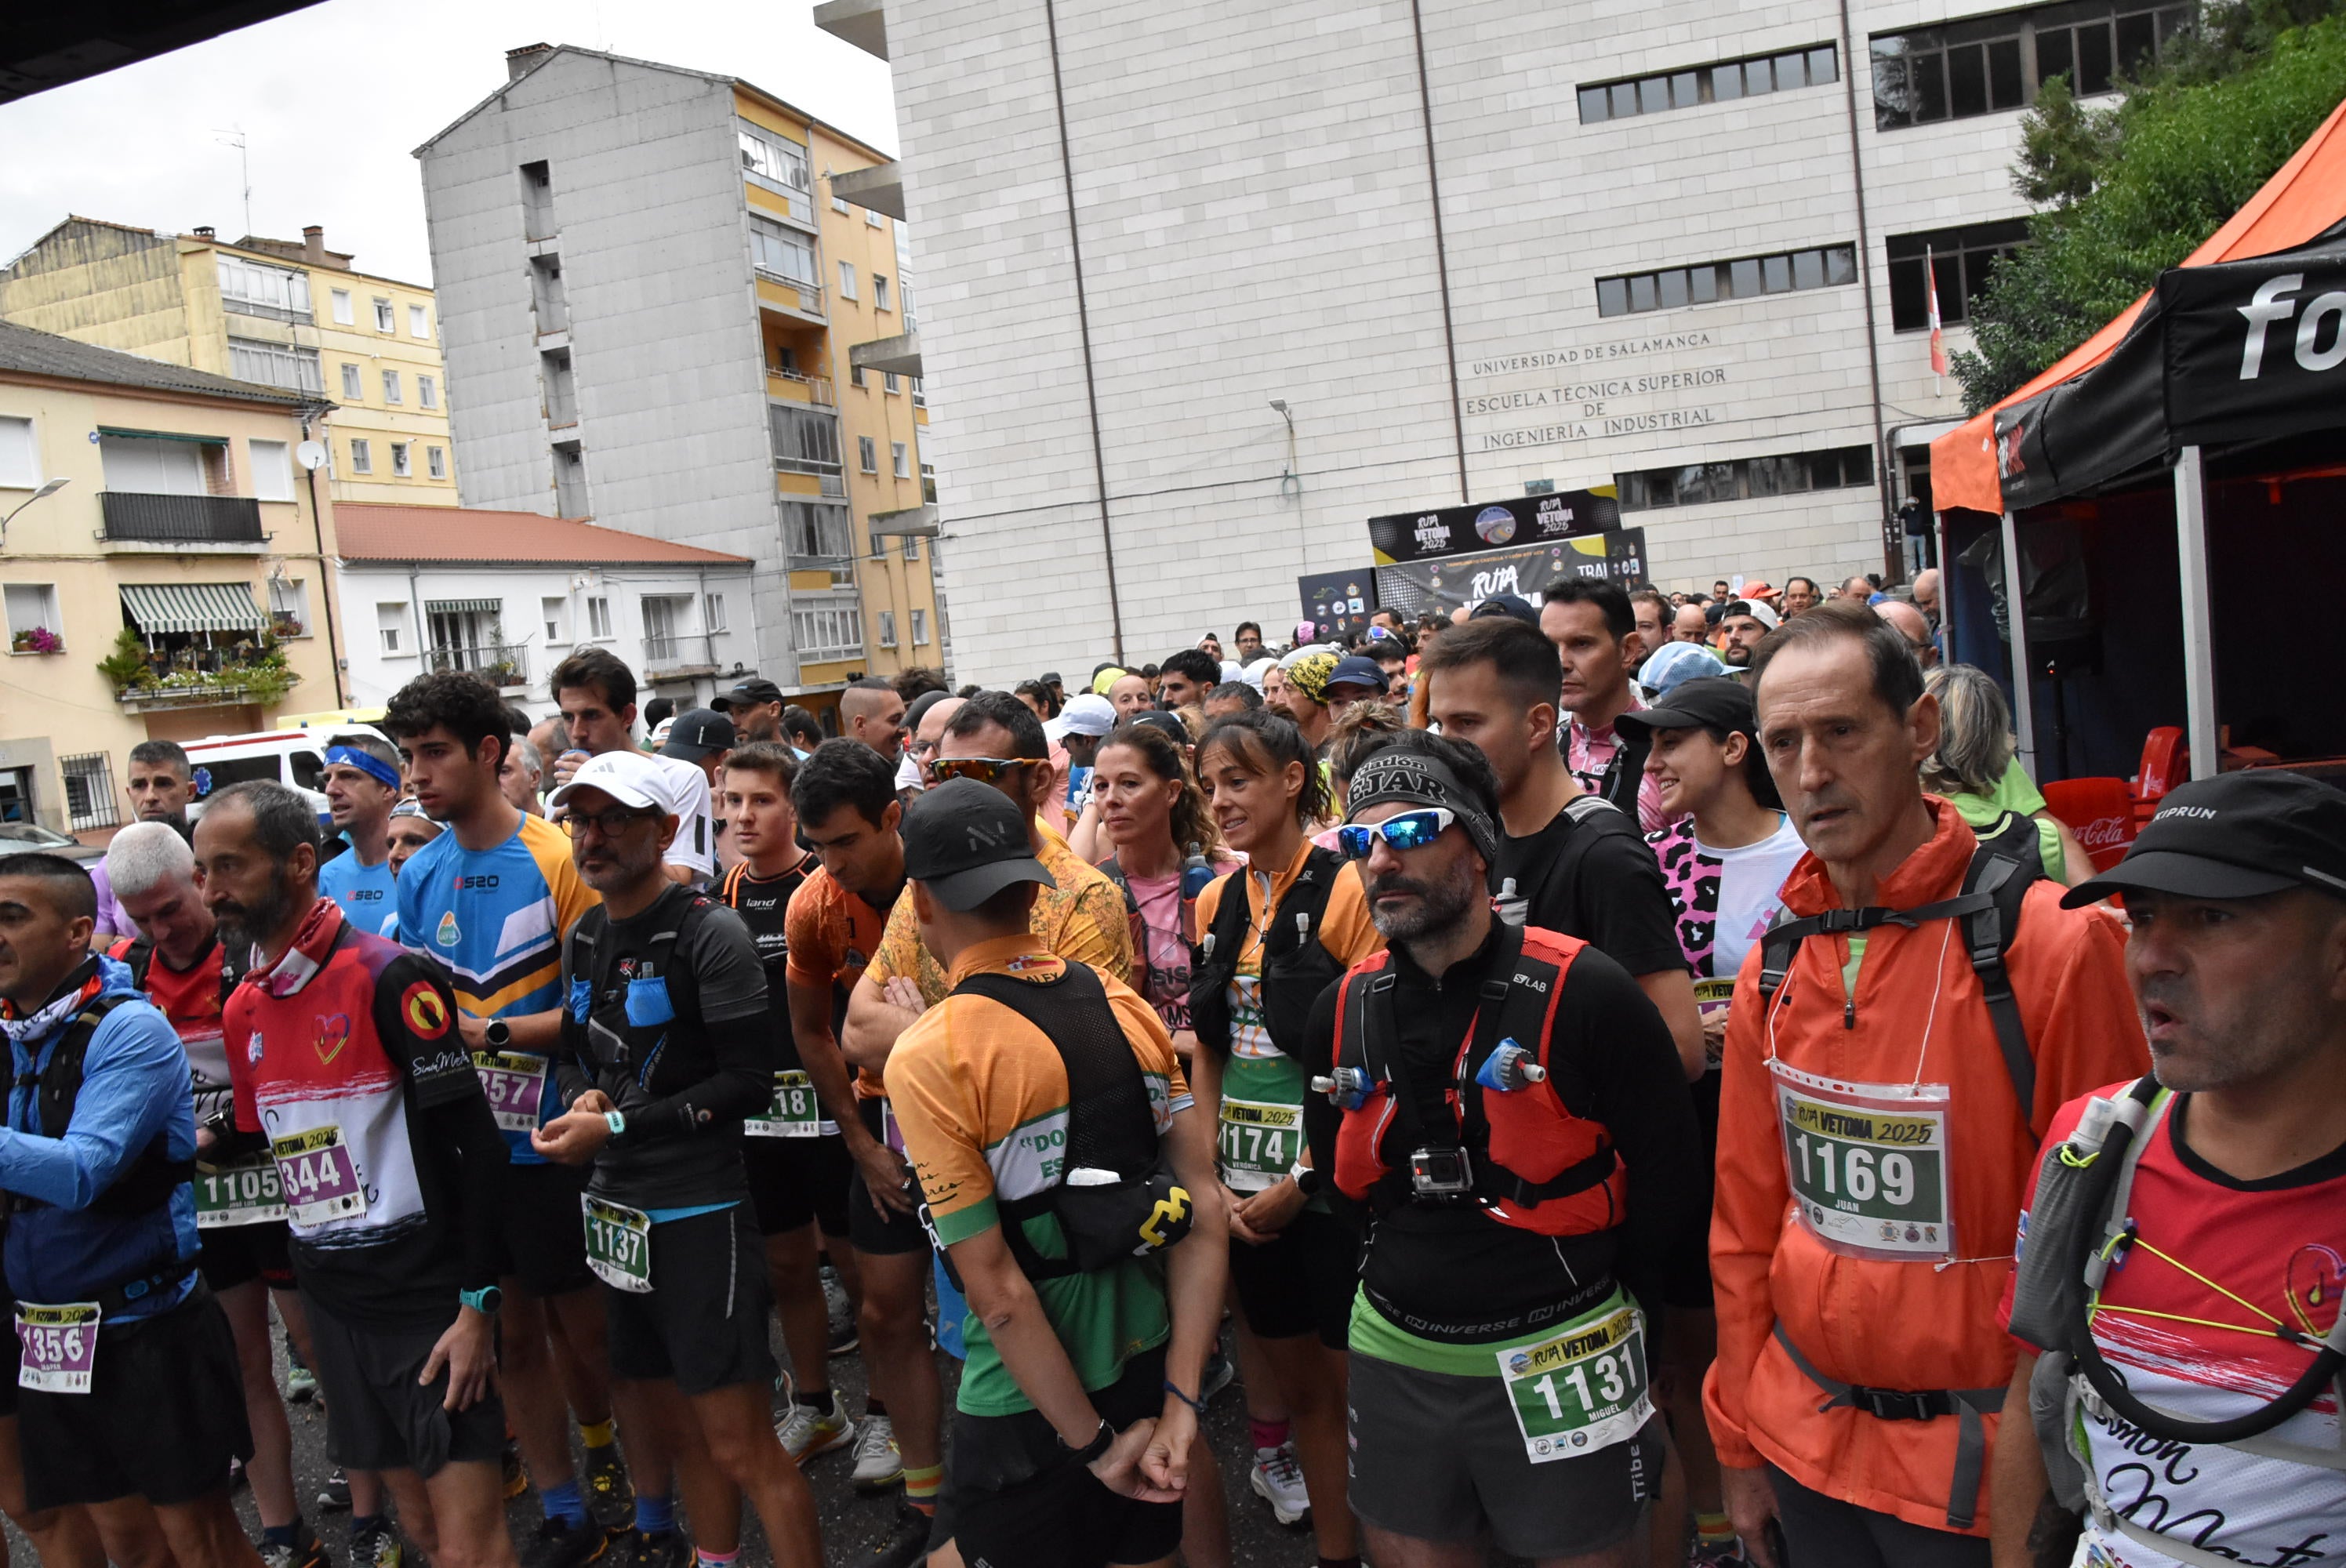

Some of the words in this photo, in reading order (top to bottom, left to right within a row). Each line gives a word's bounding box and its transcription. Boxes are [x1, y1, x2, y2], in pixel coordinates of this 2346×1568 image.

[1474, 350, 1578, 375] UNIVERSIDAD
[1585, 346, 1603, 360] DE
[1610, 333, 1710, 357] SALAMANCA
[1466, 392, 1548, 415] ESCUELA
[1638, 368, 1726, 392] SUPERIOR
[1584, 403, 1606, 417] DE
[1604, 408, 1716, 434] INDUSTRIAL
[1536, 508, 1574, 525] VETONA
[1543, 521, 1569, 534] 2025
[1414, 526, 1451, 542] VETONA
[1421, 539, 1447, 550] 2025
[1471, 564, 1520, 599] RUTA
[1348, 770, 1447, 807] EJAR
[2152, 806, 2217, 822] KIPRUN
[746, 898, 776, 907] land
[768, 1090, 806, 1115] 18
[1233, 1106, 1262, 1122] VETONA
[1265, 1111, 1295, 1126] 2025
[1798, 1106, 1819, 1129] RUTA
[1820, 1111, 1872, 1139] VETONA
[1877, 1123, 1932, 1143] 2025
[1222, 1122, 1284, 1165] 1174
[280, 1151, 340, 1197] 344
[1796, 1133, 1914, 1206] 1169
[204, 1169, 279, 1203] 1105
[1835, 1199, 1860, 1213] JUAN
[593, 1220, 640, 1266] 1137
[1429, 1316, 1521, 1334] INVERSE
[24, 1326, 84, 1363] 1356
[1534, 1345, 1562, 1367] RUTA
[1561, 1327, 1610, 1359] VETONA
[1533, 1343, 1637, 1419] 1131
[1588, 1403, 1621, 1423] MIGUEL
